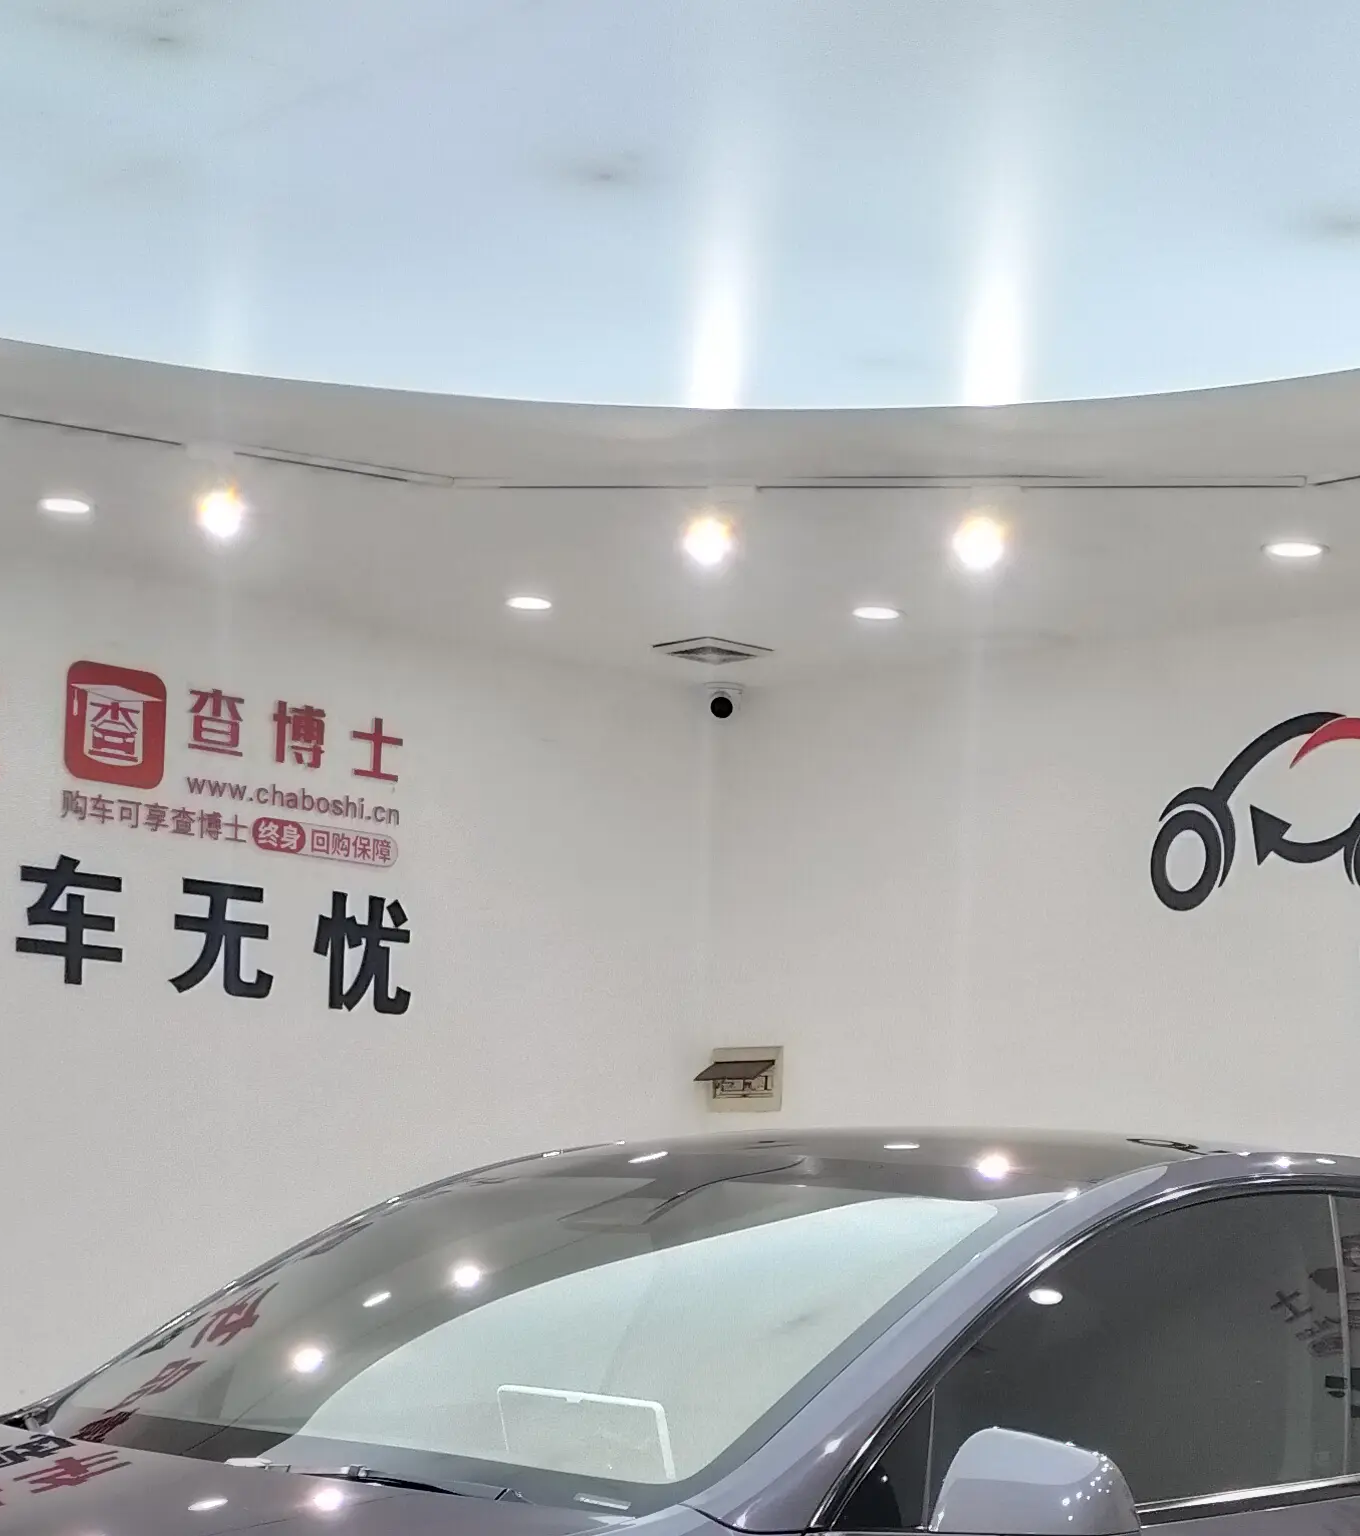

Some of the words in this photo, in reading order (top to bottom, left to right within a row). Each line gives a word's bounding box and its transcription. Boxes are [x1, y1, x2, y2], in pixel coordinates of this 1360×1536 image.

[187, 687, 404, 783] 查博士
[186, 775, 401, 826] www.chaboshi.cn
[256, 820, 303, 851] 终身
[310, 827, 393, 864] 回购保障
